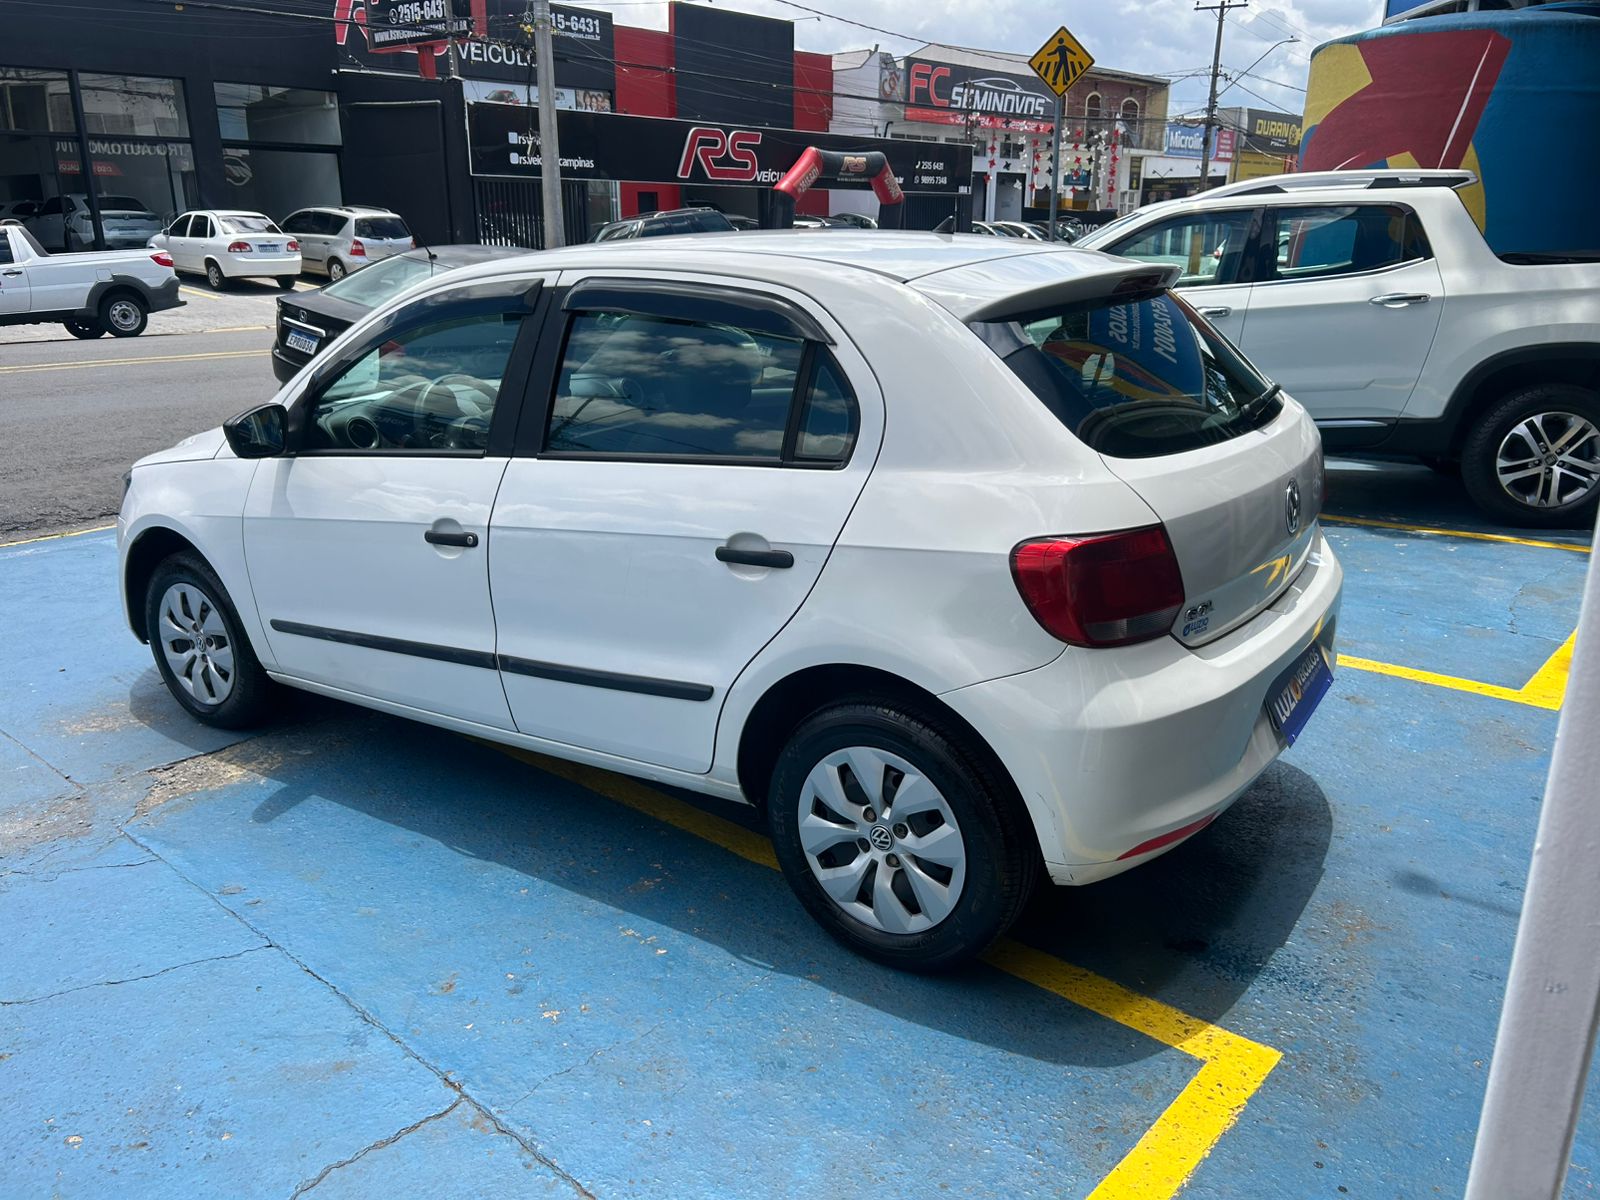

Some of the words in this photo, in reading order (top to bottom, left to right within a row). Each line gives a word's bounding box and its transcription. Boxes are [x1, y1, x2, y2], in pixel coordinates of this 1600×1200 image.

[398, 0, 447, 23] 2515-6431
[550, 12, 601, 34] 15-6431
[457, 37, 538, 67] VEICUL
[909, 63, 951, 107] FC
[950, 84, 1046, 117] SEMINOVOS
[677, 127, 763, 182] RS
[756, 167, 787, 183] VEÍCU
[1274, 675, 1302, 724] LUZIO
